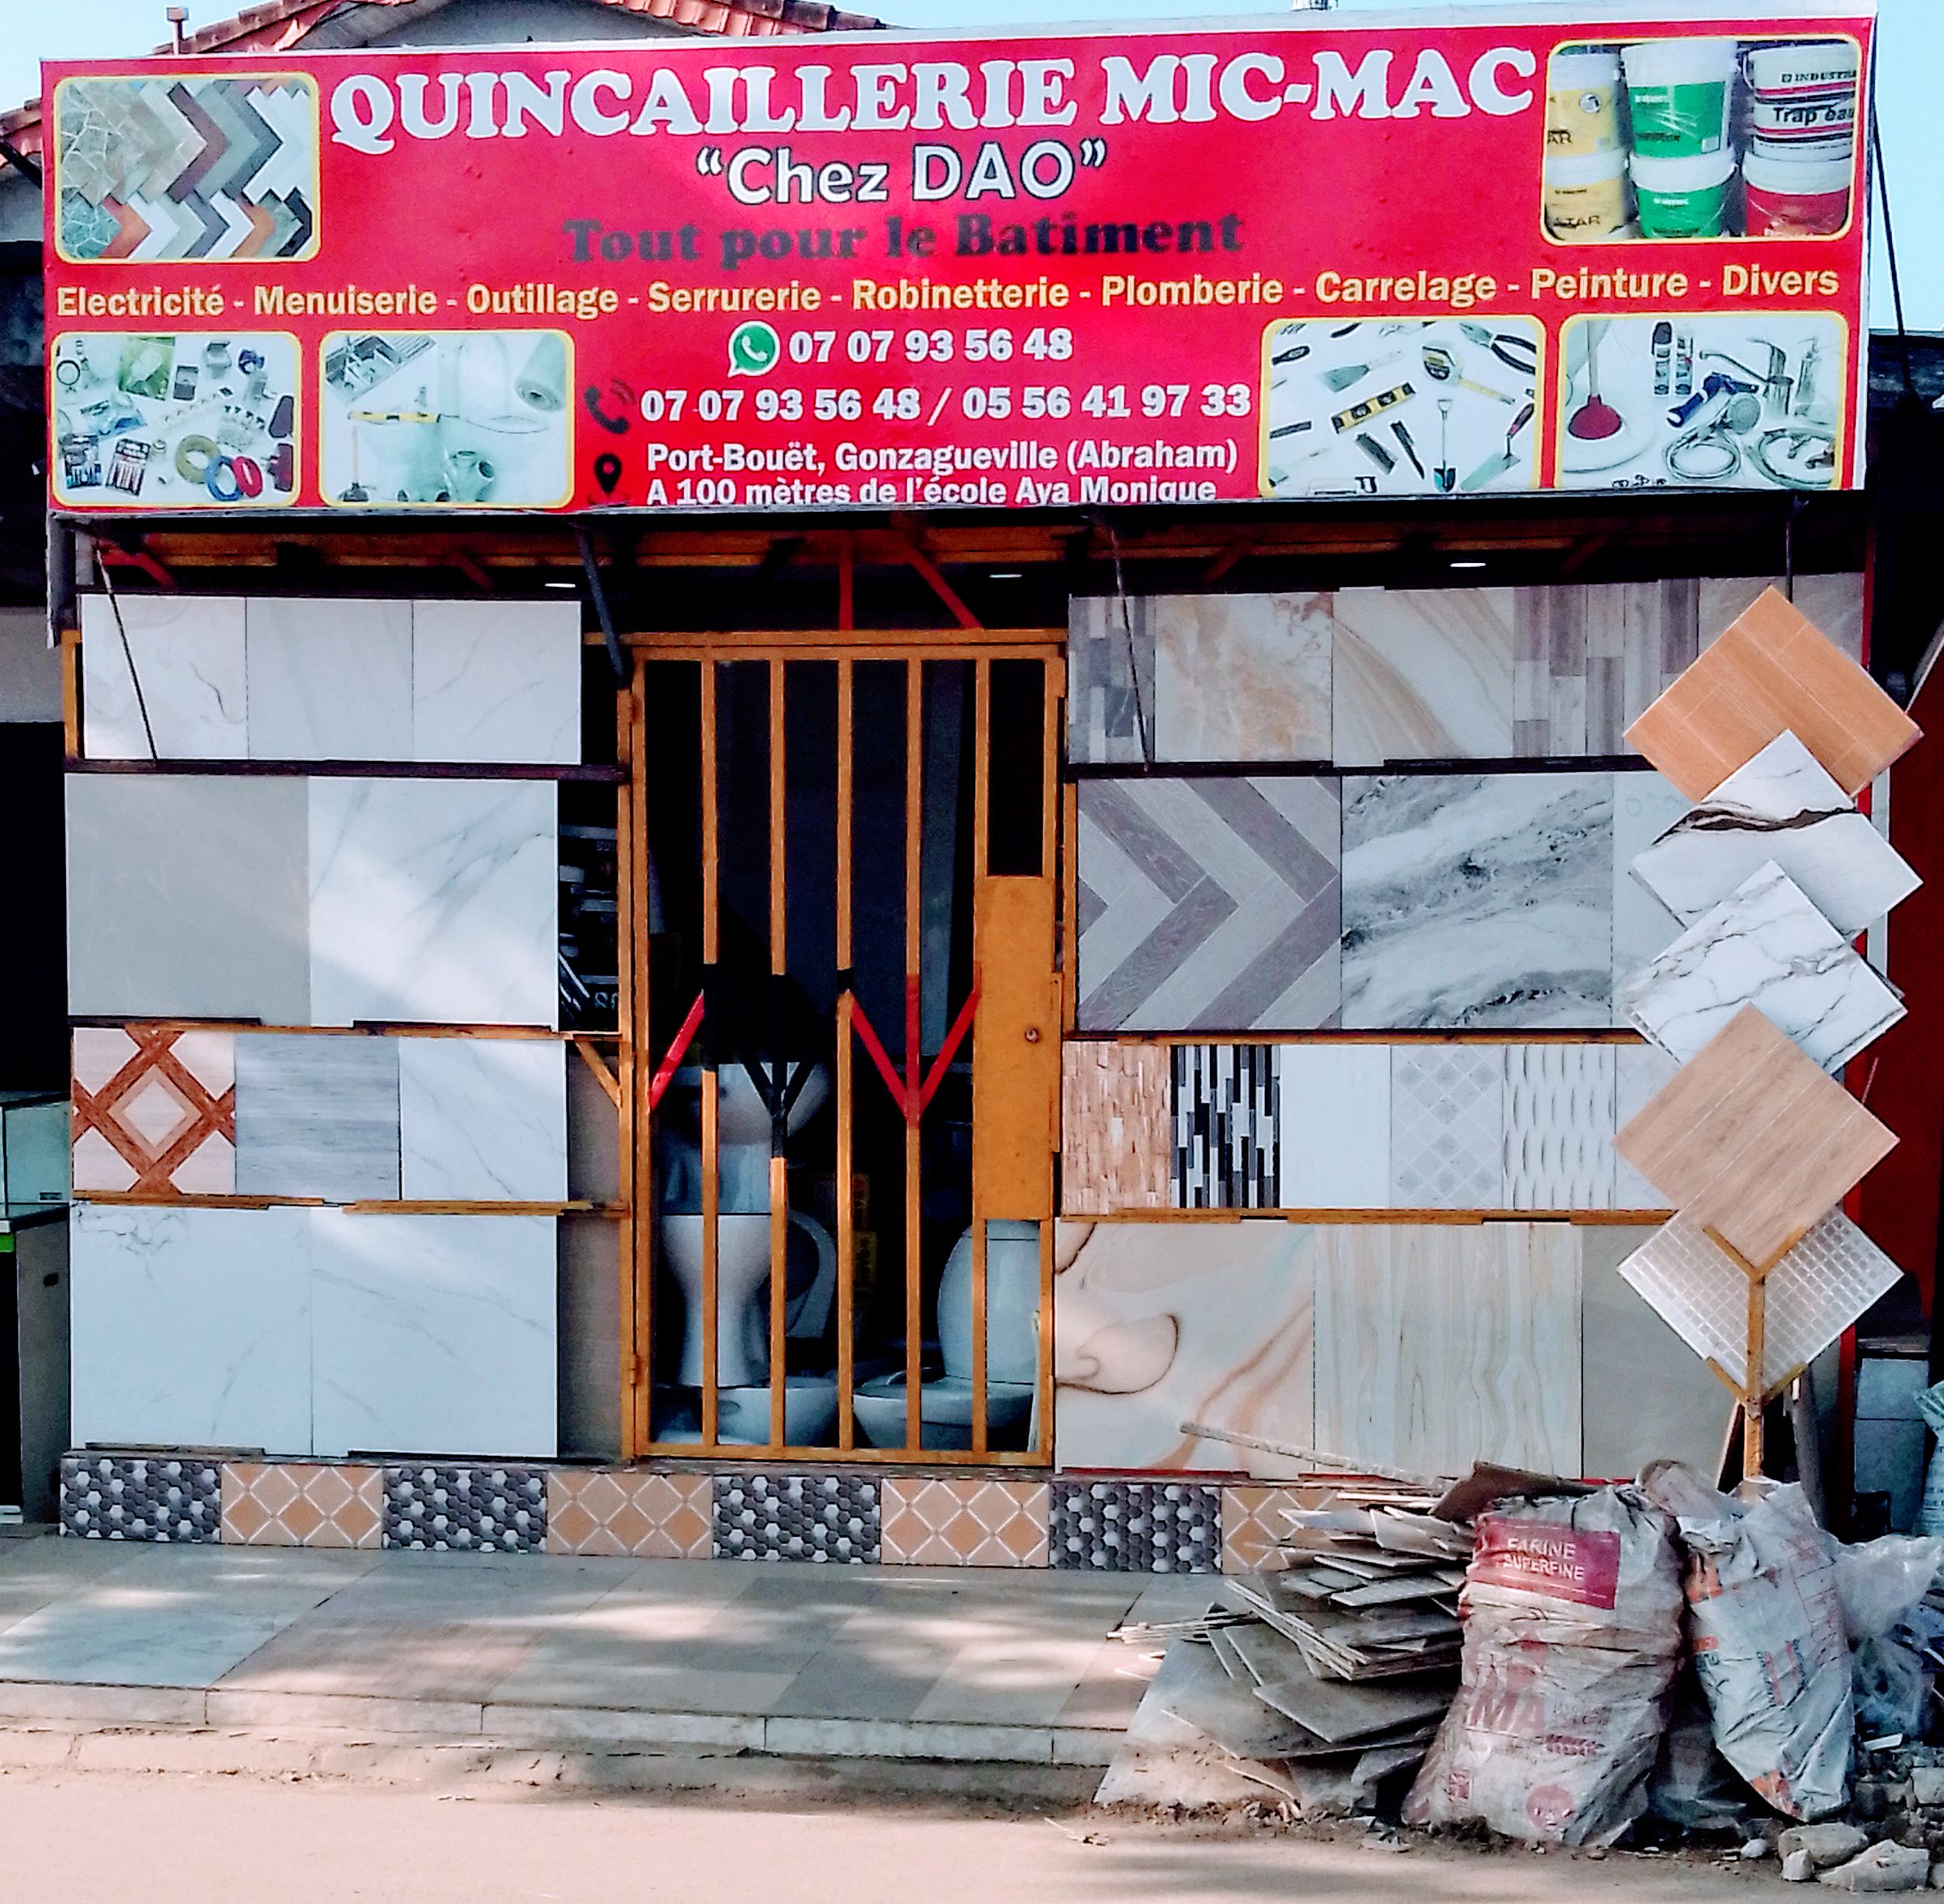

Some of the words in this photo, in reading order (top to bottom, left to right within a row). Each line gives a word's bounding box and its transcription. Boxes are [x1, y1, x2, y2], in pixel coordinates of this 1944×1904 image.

[330, 57, 1080, 155] QUINCAILLERIE
[1099, 47, 1536, 124] MIC-MAC
[697, 144, 889, 204] “Chez
[911, 137, 1107, 200] DAO”
[562, 218, 699, 262] Tout
[720, 228, 866, 271] pour
[886, 215, 936, 257] le
[956, 211, 1245, 256] Batiment
[57, 283, 224, 316] Electricité
[254, 284, 437, 314] Menuiserie
[466, 283, 619, 320] Outillage
[647, 280, 821, 312] Serrurerie
[852, 276, 1070, 311] Robinetterie
[1102, 272, 1284, 307] Plomberie
[1315, 270, 1497, 308] Carrelage
[1530, 266, 1689, 300] Peinture
[1722, 263, 1840, 297] Divers
[789, 331, 836, 363] 07
[847, 330, 894, 363] 07
[905, 329, 954, 362] 93
[964, 328, 1013, 361] 56
[1022, 328, 1073, 361] 48
[640, 390, 688, 422] 07
[699, 389, 745, 421] 07
[755, 389, 804, 421] 93
[814, 389, 861, 420] 56
[872, 388, 920, 420] 48
[962, 387, 1012, 419] 05
[1021, 386, 1071, 419] 56
[1081, 385, 1131, 419] 41
[1140, 384, 1190, 417] 97
[1200, 384, 1251, 417] 33
[647, 441, 825, 476] Port-Bouët,
[835, 440, 1058, 475] Gonzagueville
[1067, 439, 1238, 475] (Abraham)
[647, 478, 668, 506] A
[676, 478, 737, 506] 100
[746, 476, 852, 506] mètres
[859, 478, 897, 503] de
[1014, 476, 1071, 505] Aya
[1080, 475, 1217, 503] Monique
[1502, 1554, 1585, 1581] SUPERFINE
